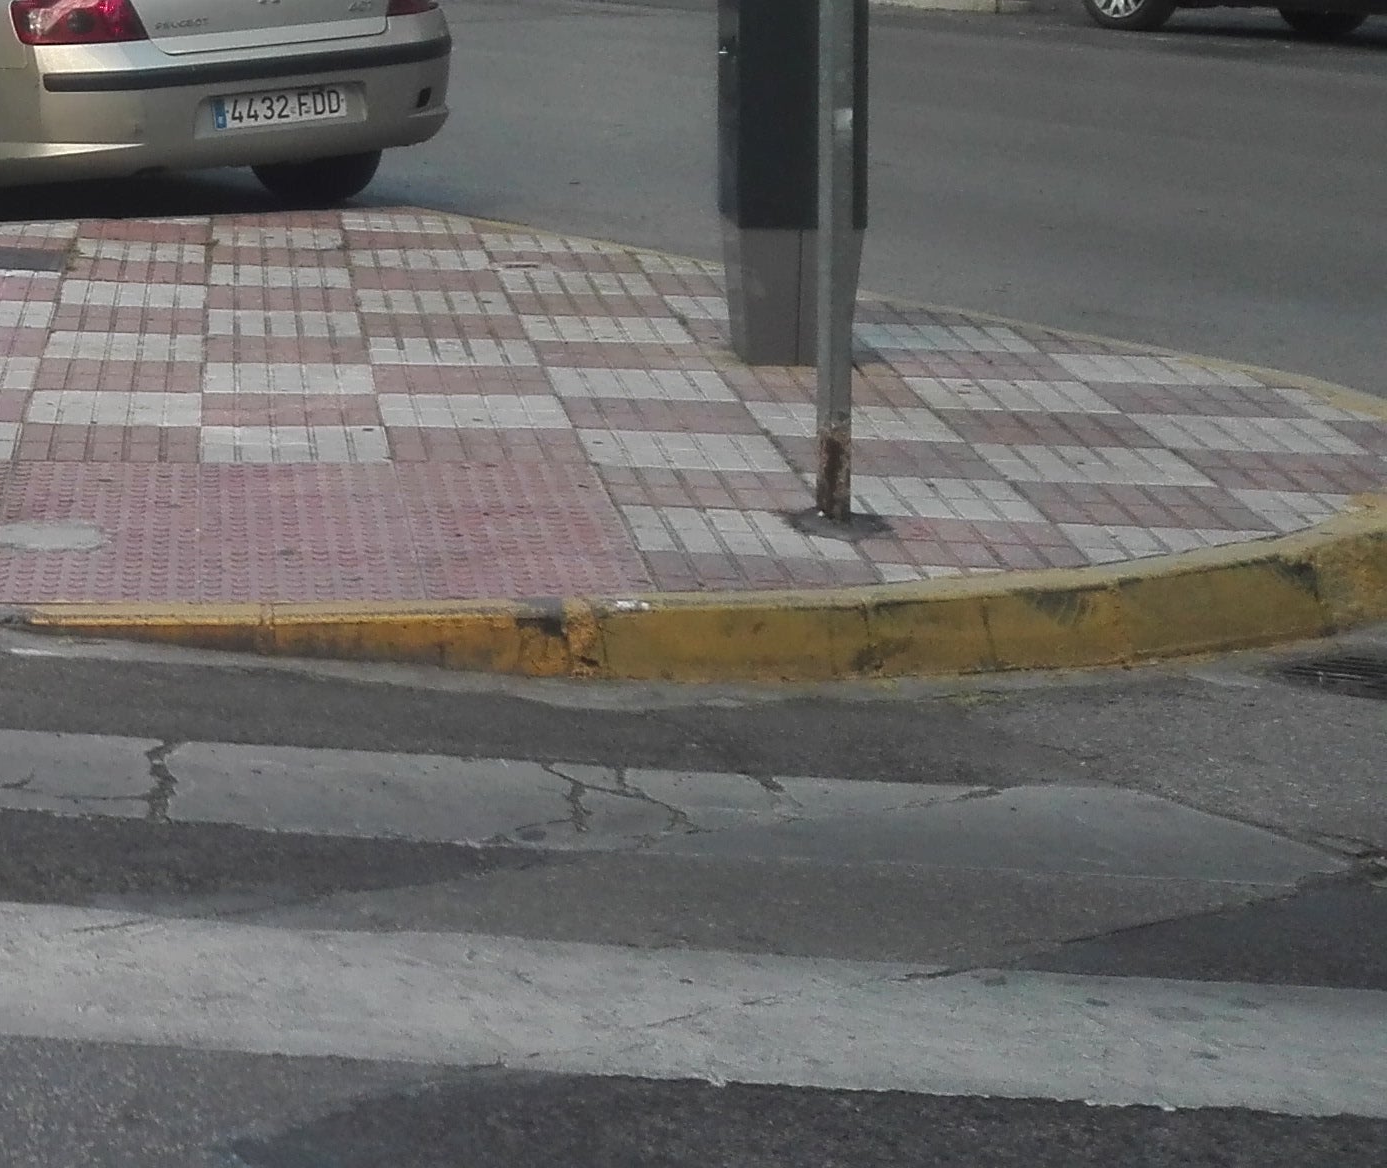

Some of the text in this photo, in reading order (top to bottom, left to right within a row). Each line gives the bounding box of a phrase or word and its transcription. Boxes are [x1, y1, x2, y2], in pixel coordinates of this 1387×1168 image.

[155, 17, 209, 31] PEUGEOT
[230, 89, 342, 124] 4432 FDD
